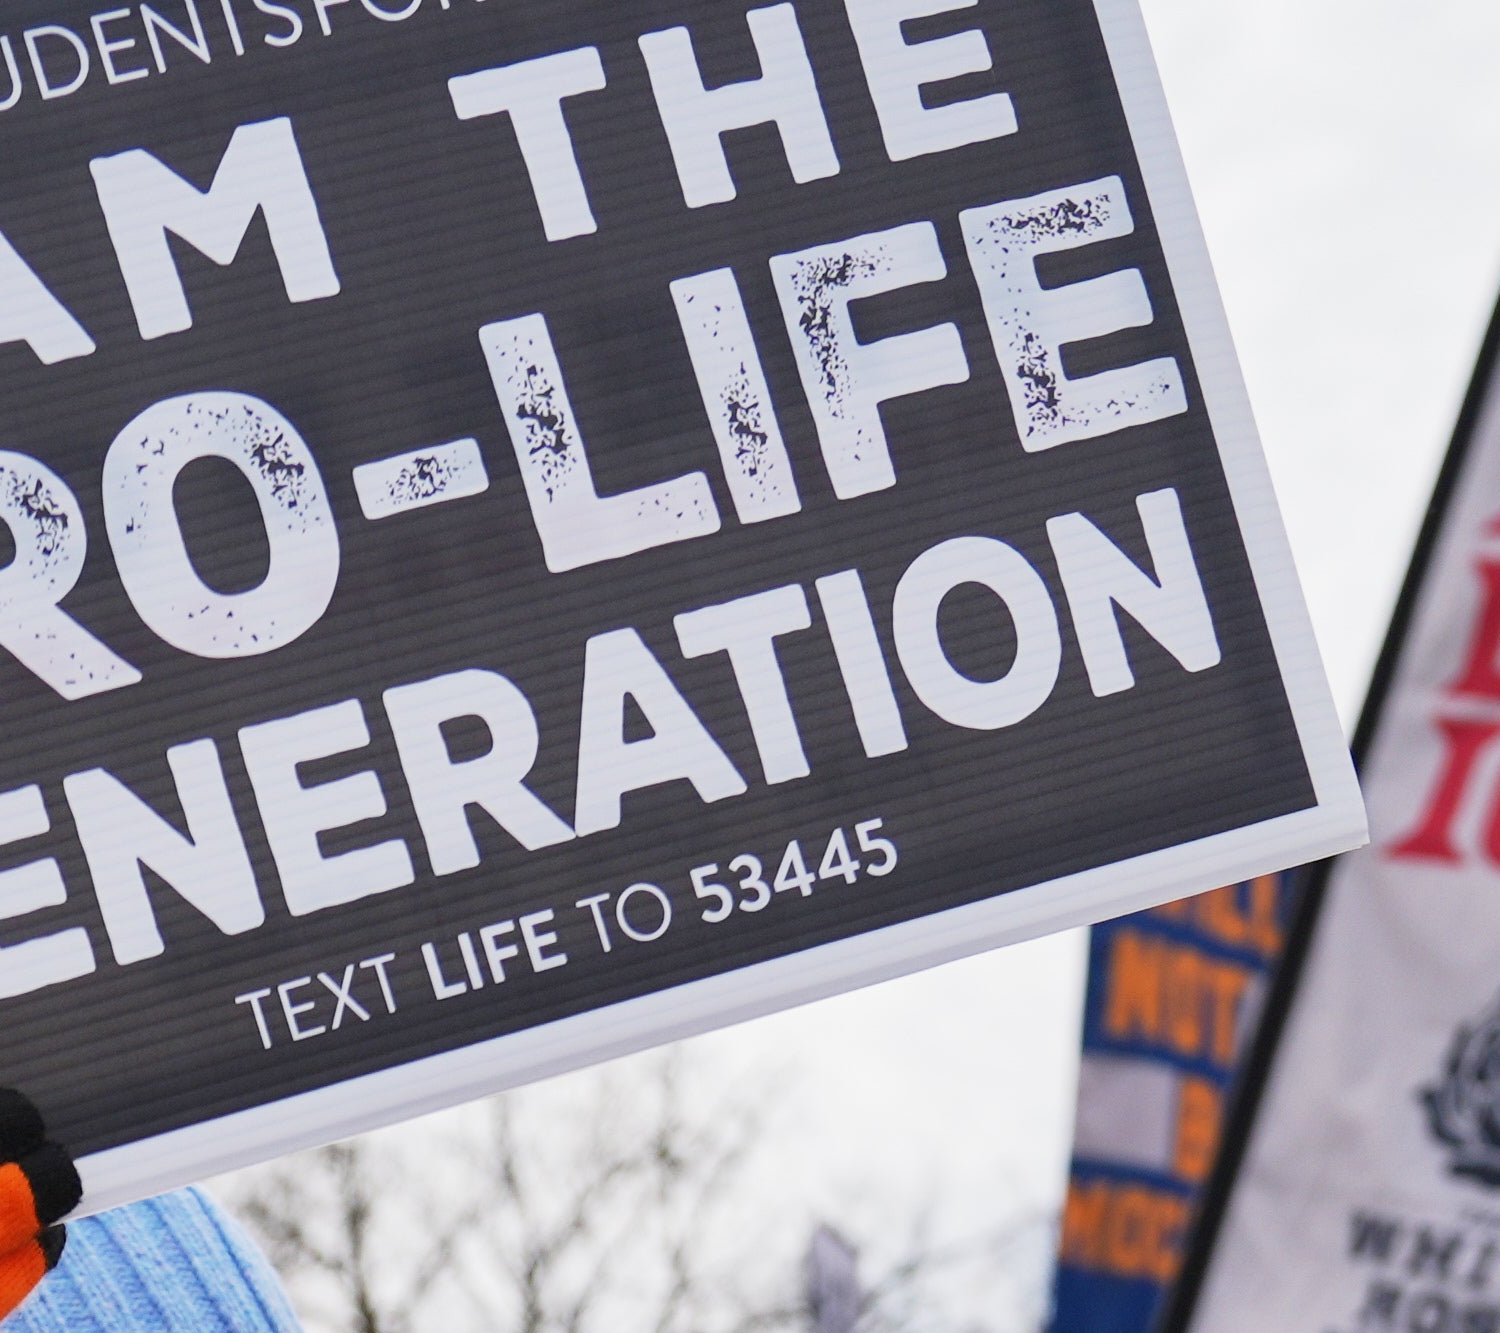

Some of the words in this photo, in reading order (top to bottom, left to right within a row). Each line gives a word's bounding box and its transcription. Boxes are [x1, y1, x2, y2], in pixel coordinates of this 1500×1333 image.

[447, 0, 1019, 242] THE
[235, 952, 397, 1050] TEXT
[420, 908, 568, 1001] LIFE
[575, 882, 672, 953] TO
[689, 817, 899, 923] 53445
